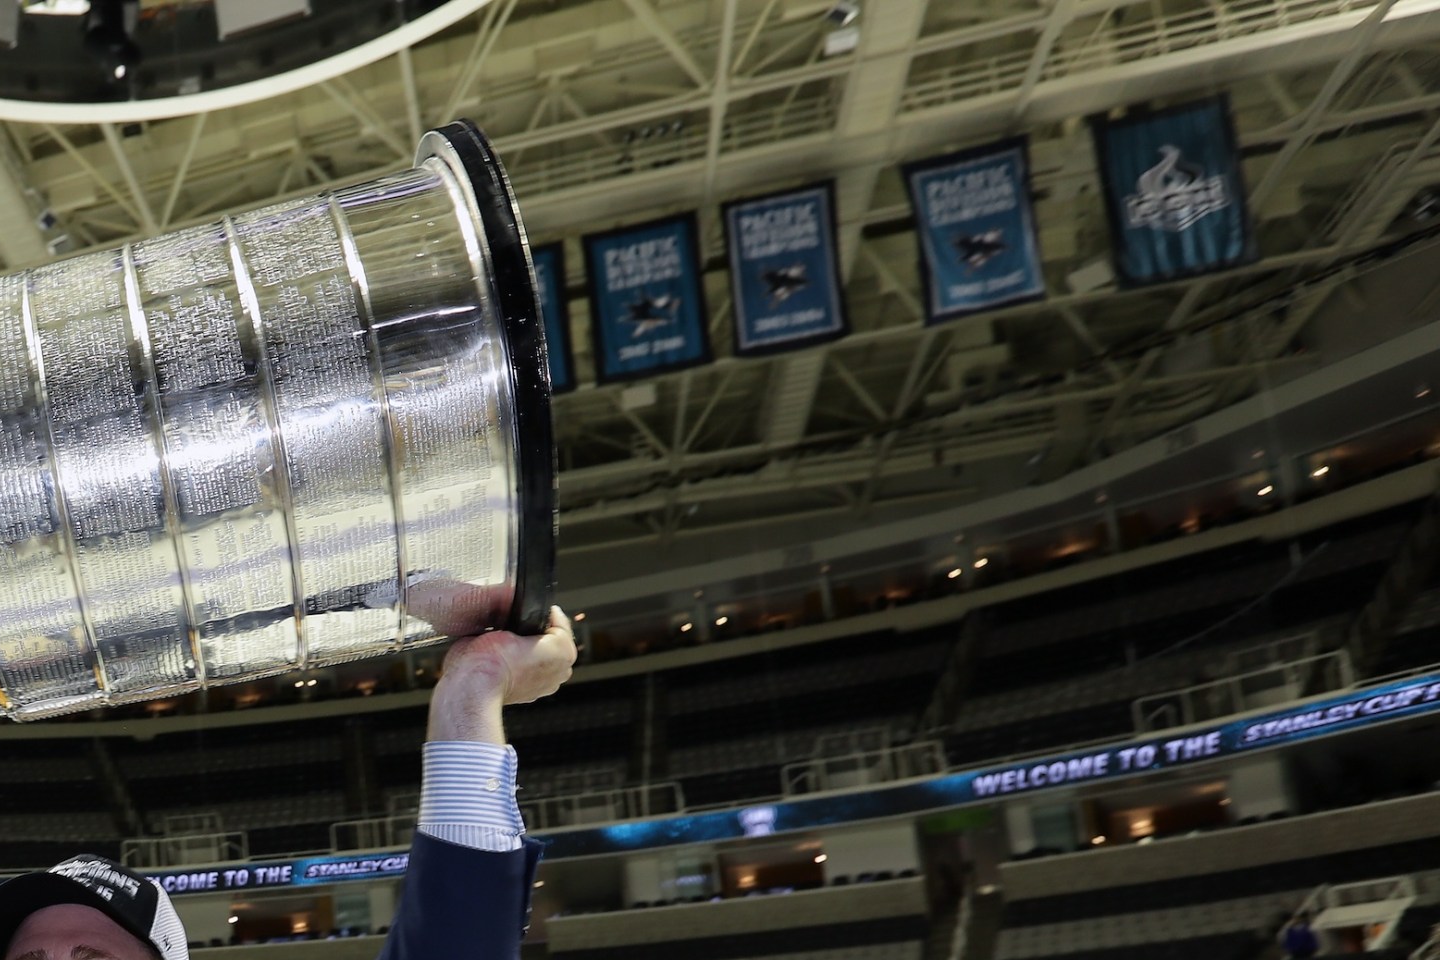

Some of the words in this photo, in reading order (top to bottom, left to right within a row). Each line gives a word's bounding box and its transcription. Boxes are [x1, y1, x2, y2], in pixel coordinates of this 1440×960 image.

[971, 751, 1111, 797] WELCOME
[1117, 744, 1160, 772] TO
[1164, 730, 1222, 763] THE
[1243, 701, 1363, 743] STANLEY
[1360, 687, 1426, 714] CUP
[223, 868, 250, 888] TO
[254, 865, 293, 884] THE
[307, 860, 382, 877] STANLEY
